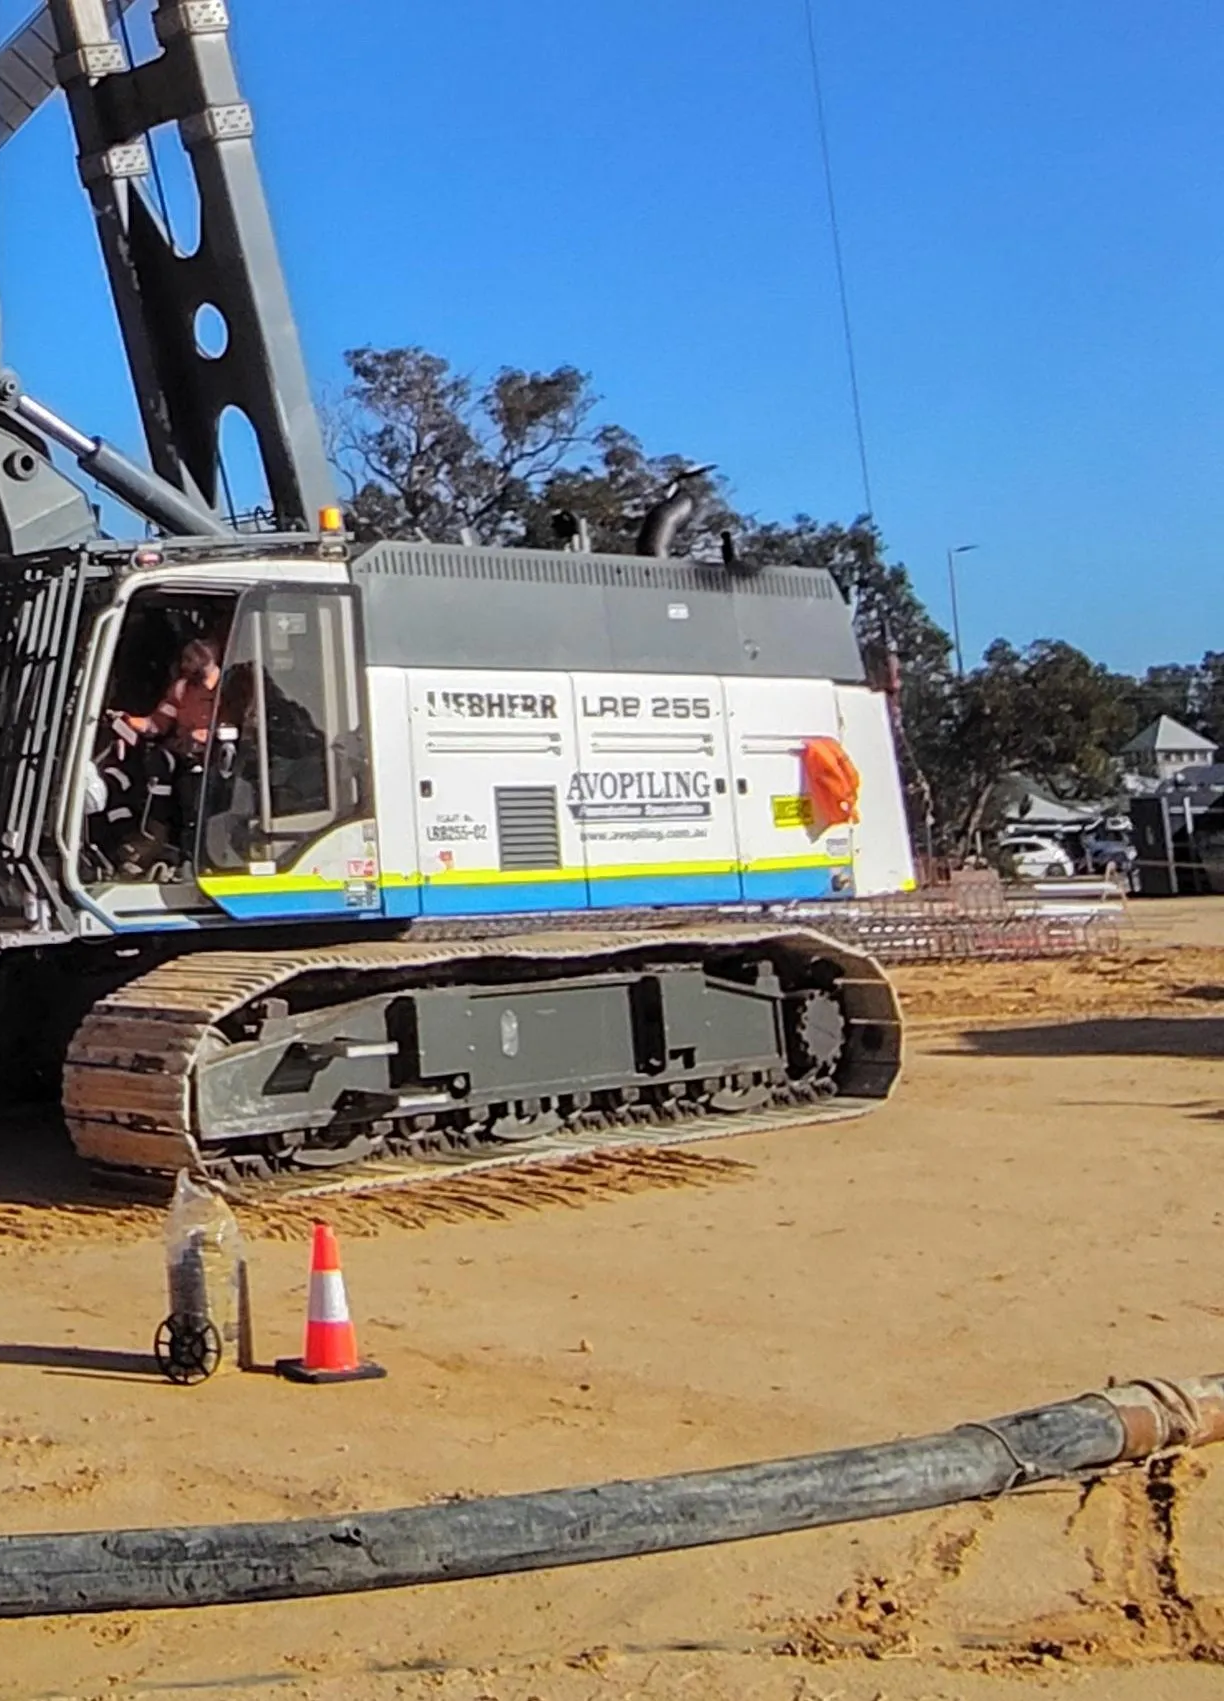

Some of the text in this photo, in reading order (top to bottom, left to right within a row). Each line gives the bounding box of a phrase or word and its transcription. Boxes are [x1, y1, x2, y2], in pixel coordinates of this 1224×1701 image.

[581, 695, 711, 719] LRB 255
[566, 770, 711, 801] AVOPILING
